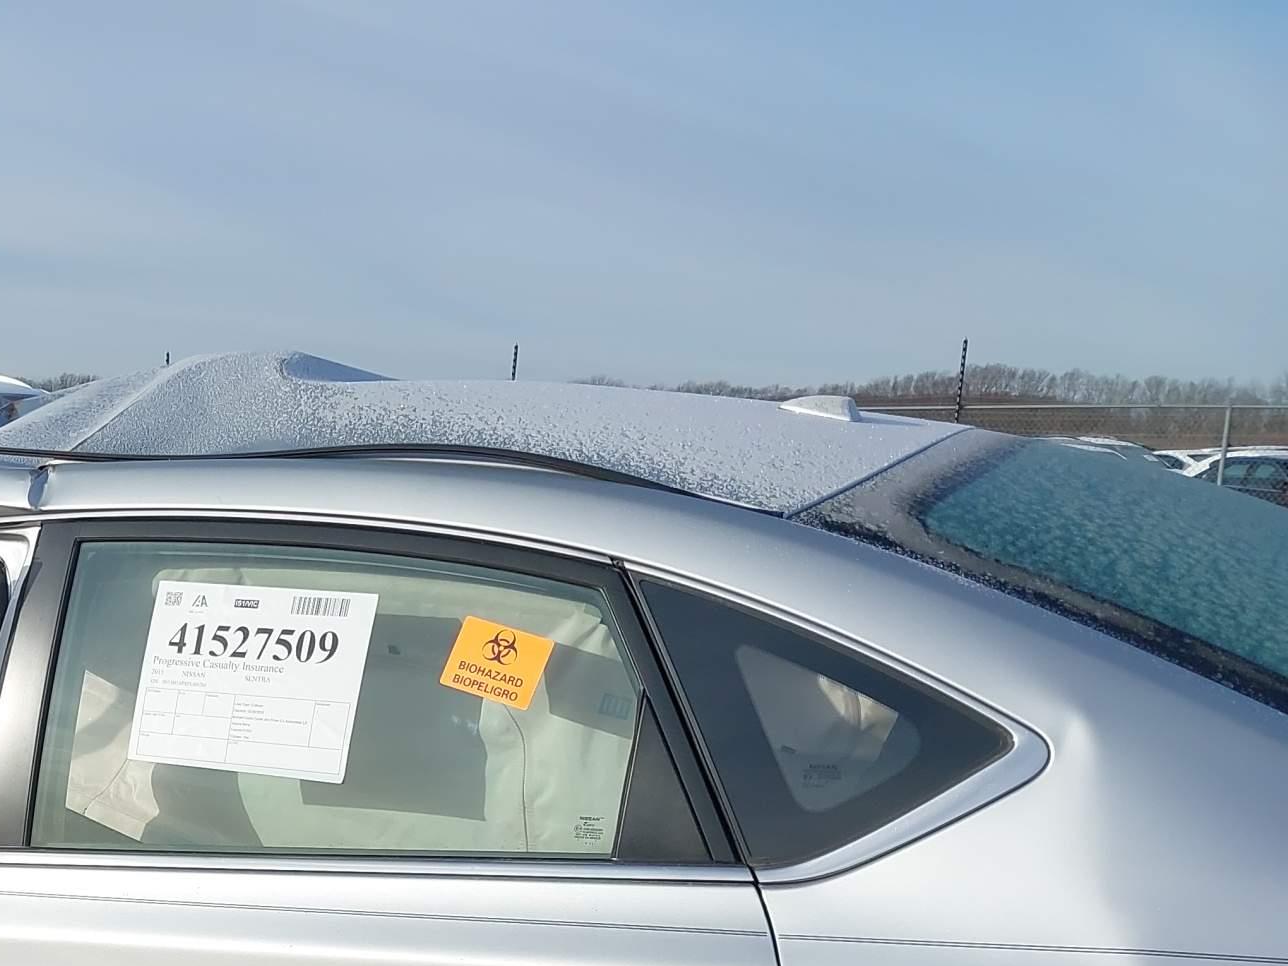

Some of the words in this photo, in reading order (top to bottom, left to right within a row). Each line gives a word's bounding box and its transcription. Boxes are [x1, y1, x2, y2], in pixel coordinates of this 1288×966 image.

[168, 622, 339, 664] 41527509
[153, 655, 201, 668] Progressive
[202, 658, 240, 672] Casualty
[242, 661, 285, 674] Insurance
[458, 660, 524, 688] BIOHAZARD
[452, 673, 519, 702] BIOPELIGRO
